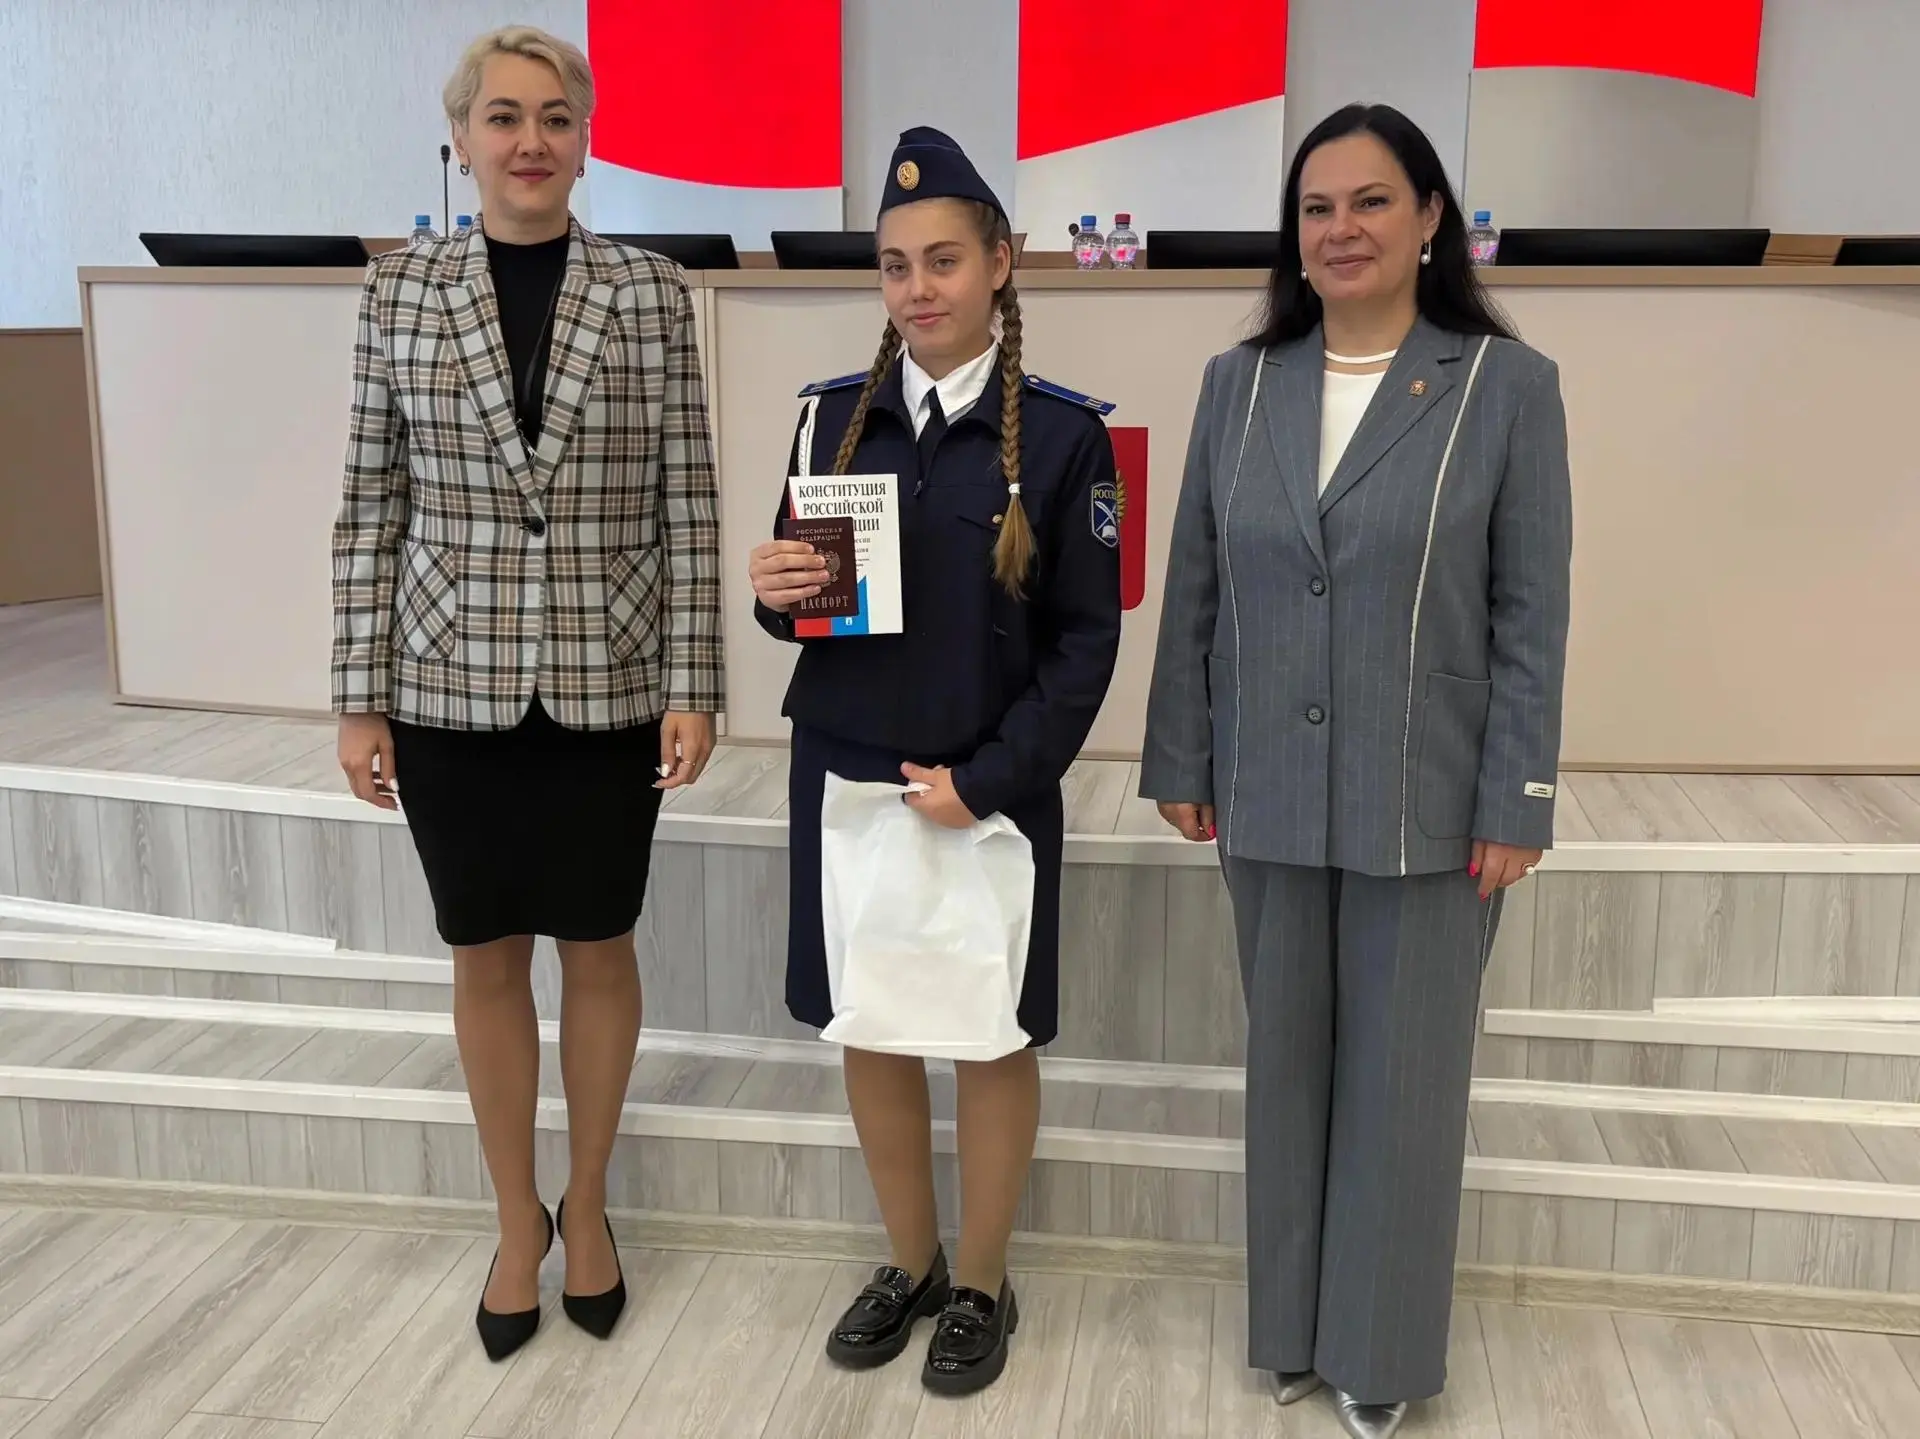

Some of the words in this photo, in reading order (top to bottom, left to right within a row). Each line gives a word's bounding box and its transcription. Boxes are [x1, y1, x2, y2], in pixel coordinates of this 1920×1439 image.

[799, 483, 886, 498] КОНСТИТУЦИЯ
[803, 498, 883, 516] РОССИЙСКОЙ
[801, 596, 849, 610] ПАСПОРТ
